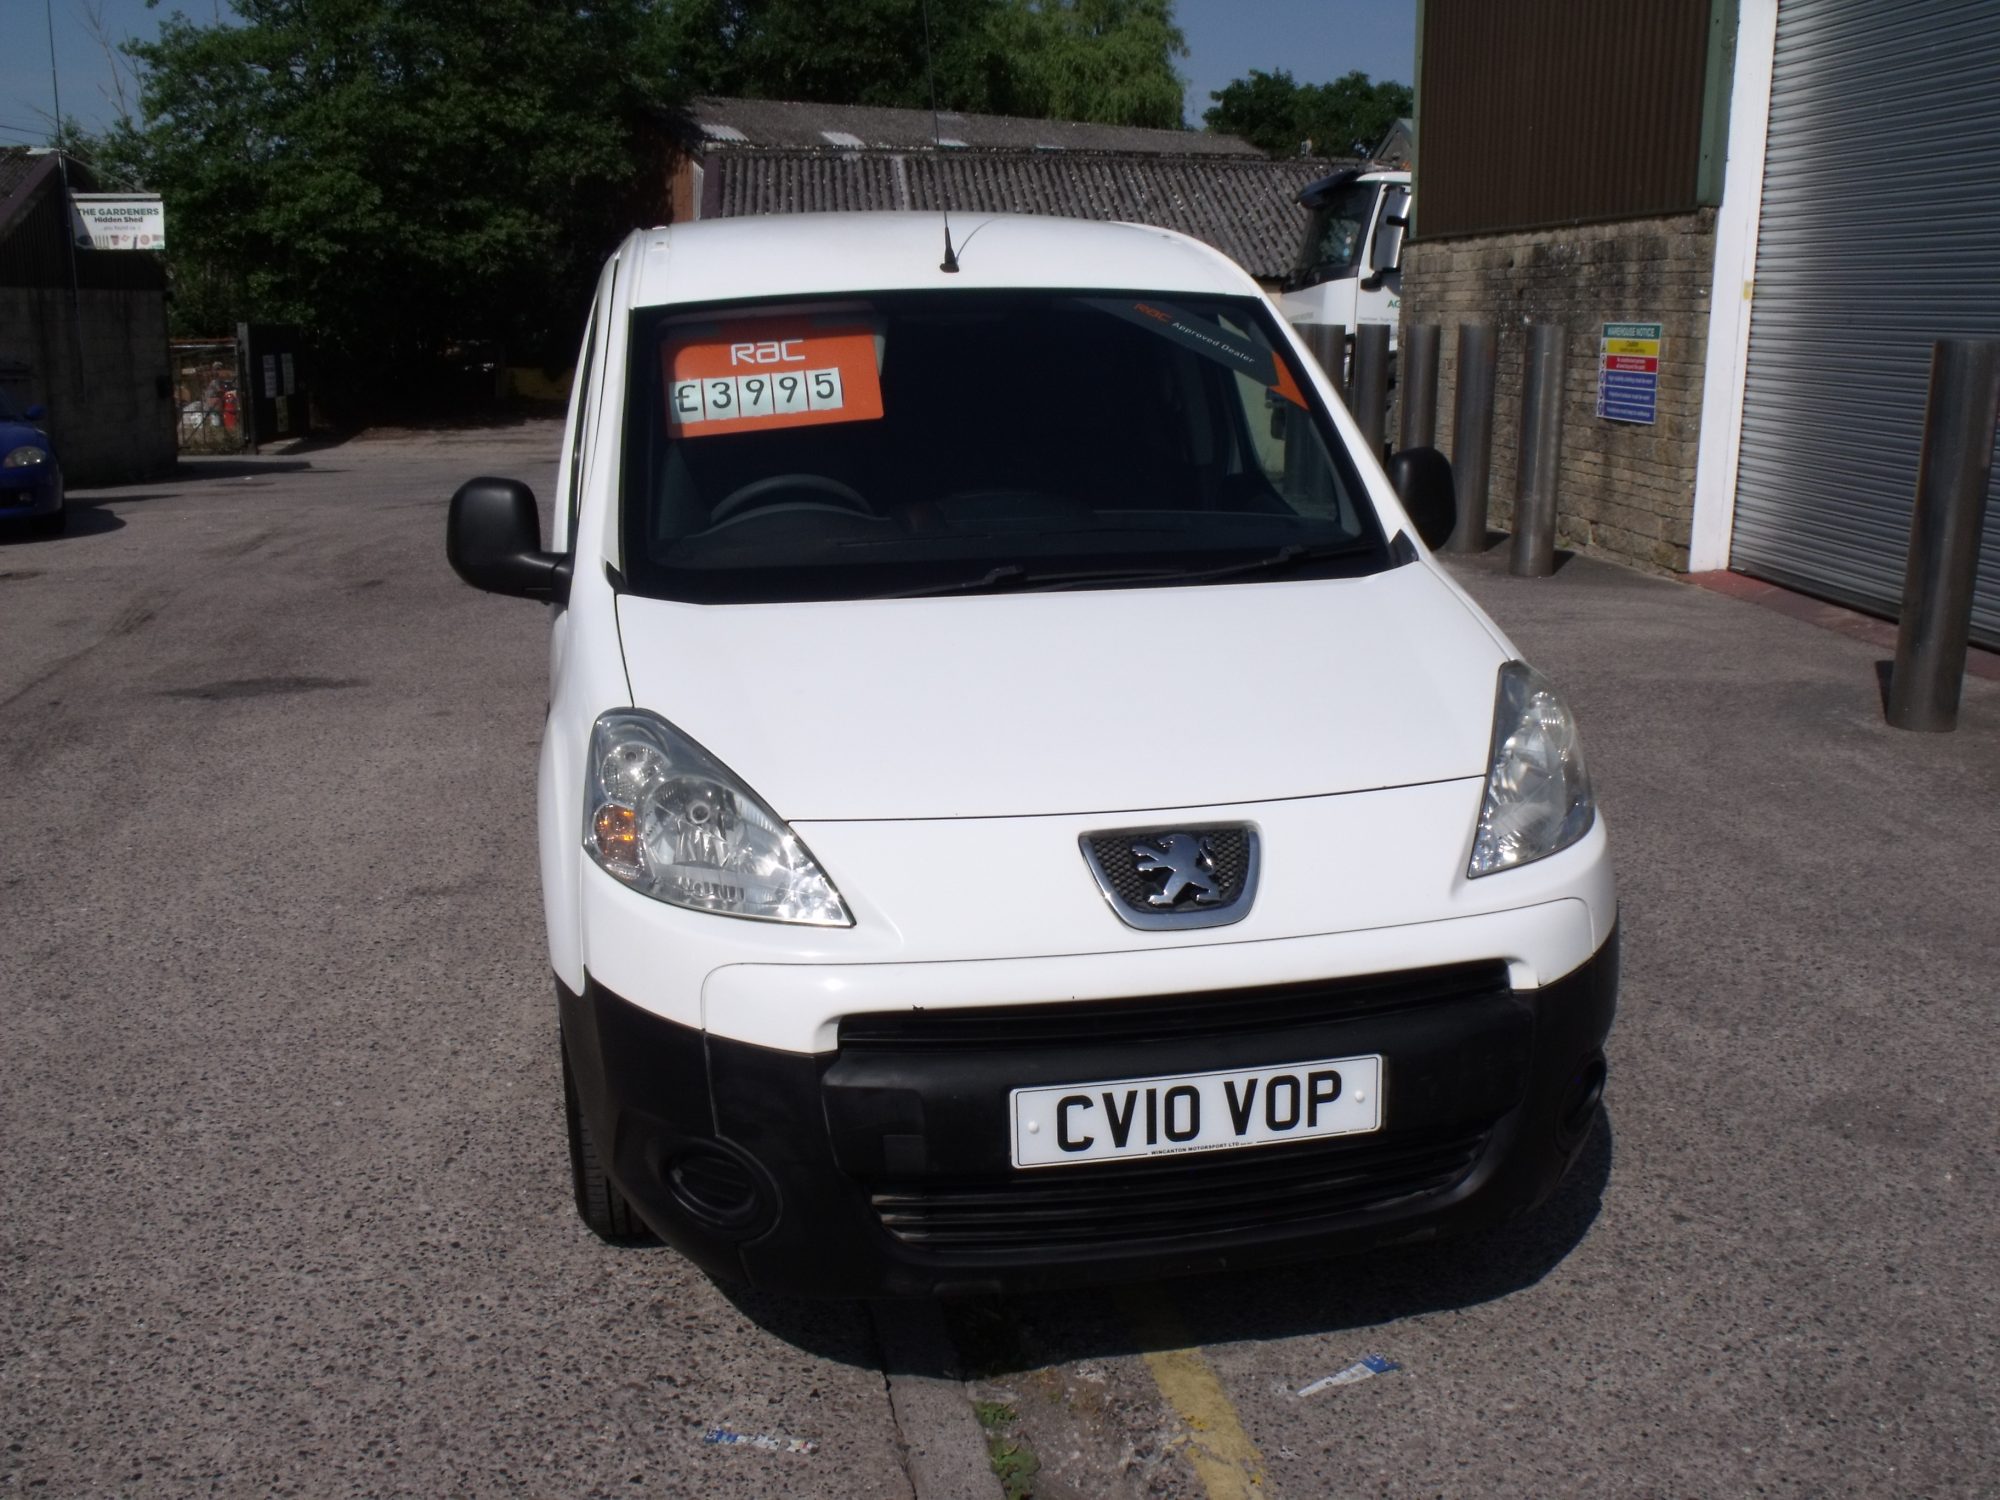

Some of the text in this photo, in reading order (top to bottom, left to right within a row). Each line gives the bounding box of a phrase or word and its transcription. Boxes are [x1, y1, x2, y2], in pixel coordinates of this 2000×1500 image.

[77, 208, 160, 216] THE GARDENERS
[1171, 321, 1219, 348] Approved
[1220, 343, 1256, 364] Dealer
[675, 372, 836, 413] £3995
[1056, 1069, 1343, 1153] CV10 VOP
[1151, 1147, 1187, 1155] WINCANTON
[1188, 1142, 1227, 1152] MOTORSPORT
